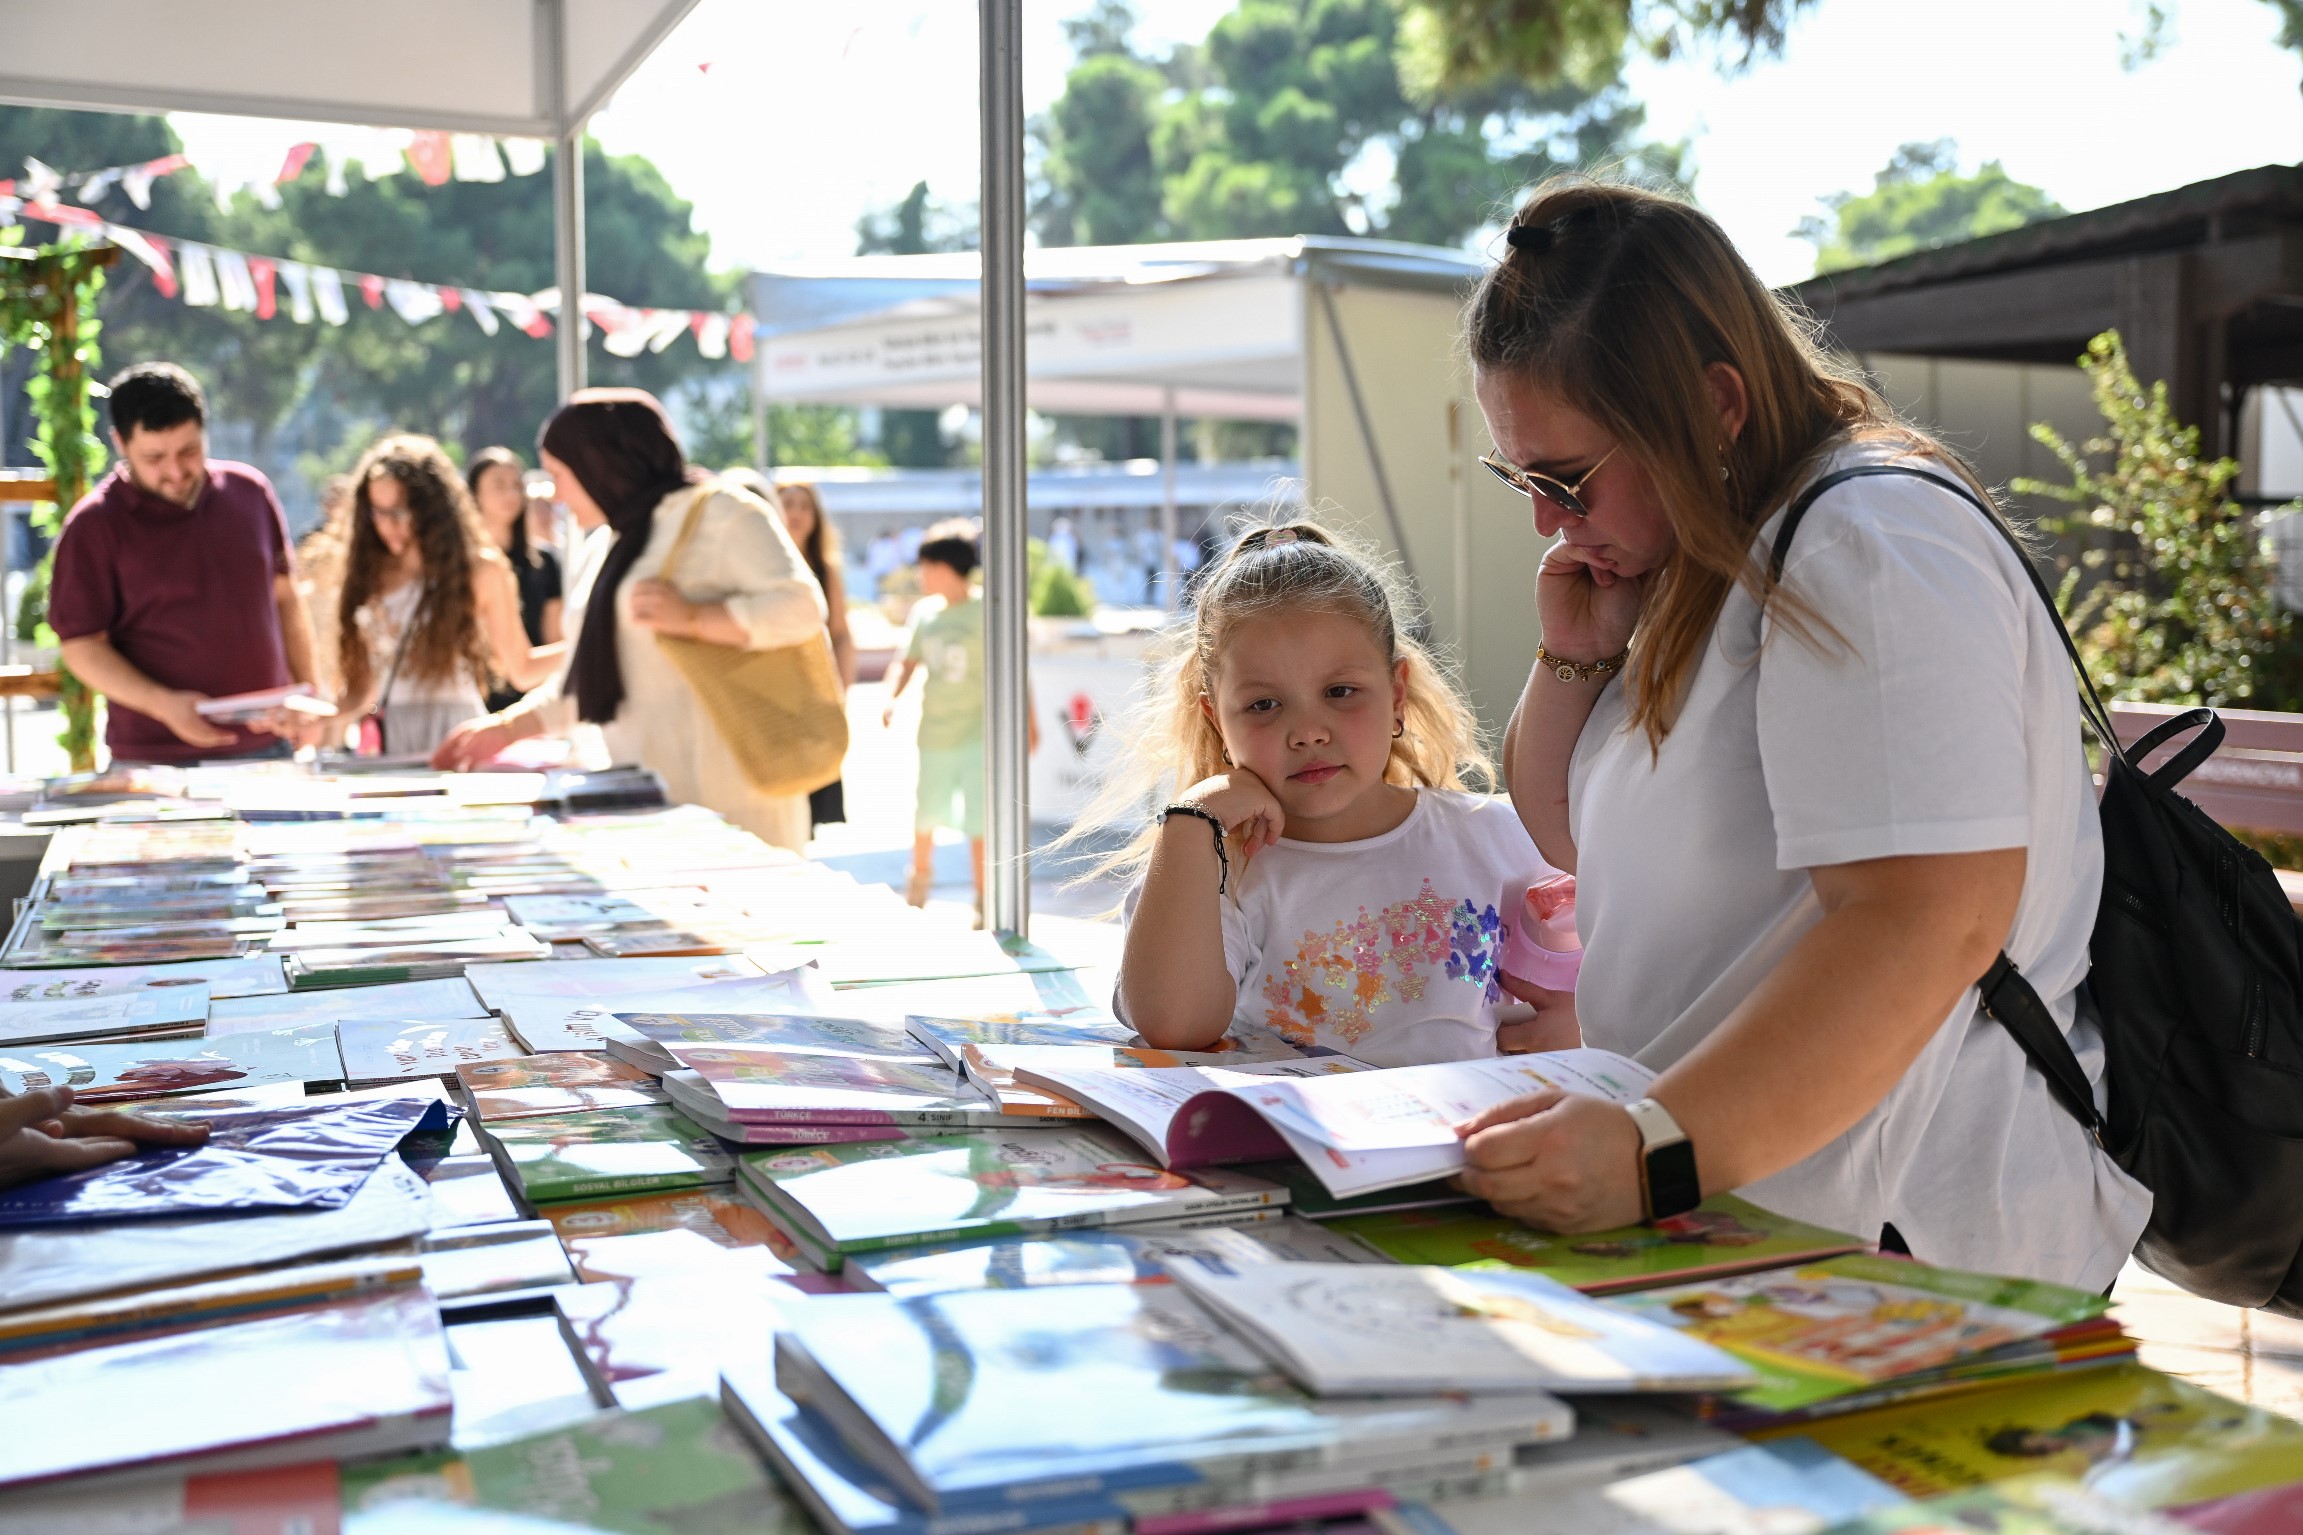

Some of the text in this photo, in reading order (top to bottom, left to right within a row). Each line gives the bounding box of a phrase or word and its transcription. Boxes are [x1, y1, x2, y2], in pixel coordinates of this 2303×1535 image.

[774, 1109, 812, 1121] TÜRKÇE
[1047, 1106, 1066, 1115] FEN
[931, 1114, 953, 1122] SINIF
[791, 1128, 830, 1141] TÜRKÇE
[572, 1176, 660, 1192] SOSYAL BİLGİLER
[1063, 1216, 1087, 1225] SINIF
